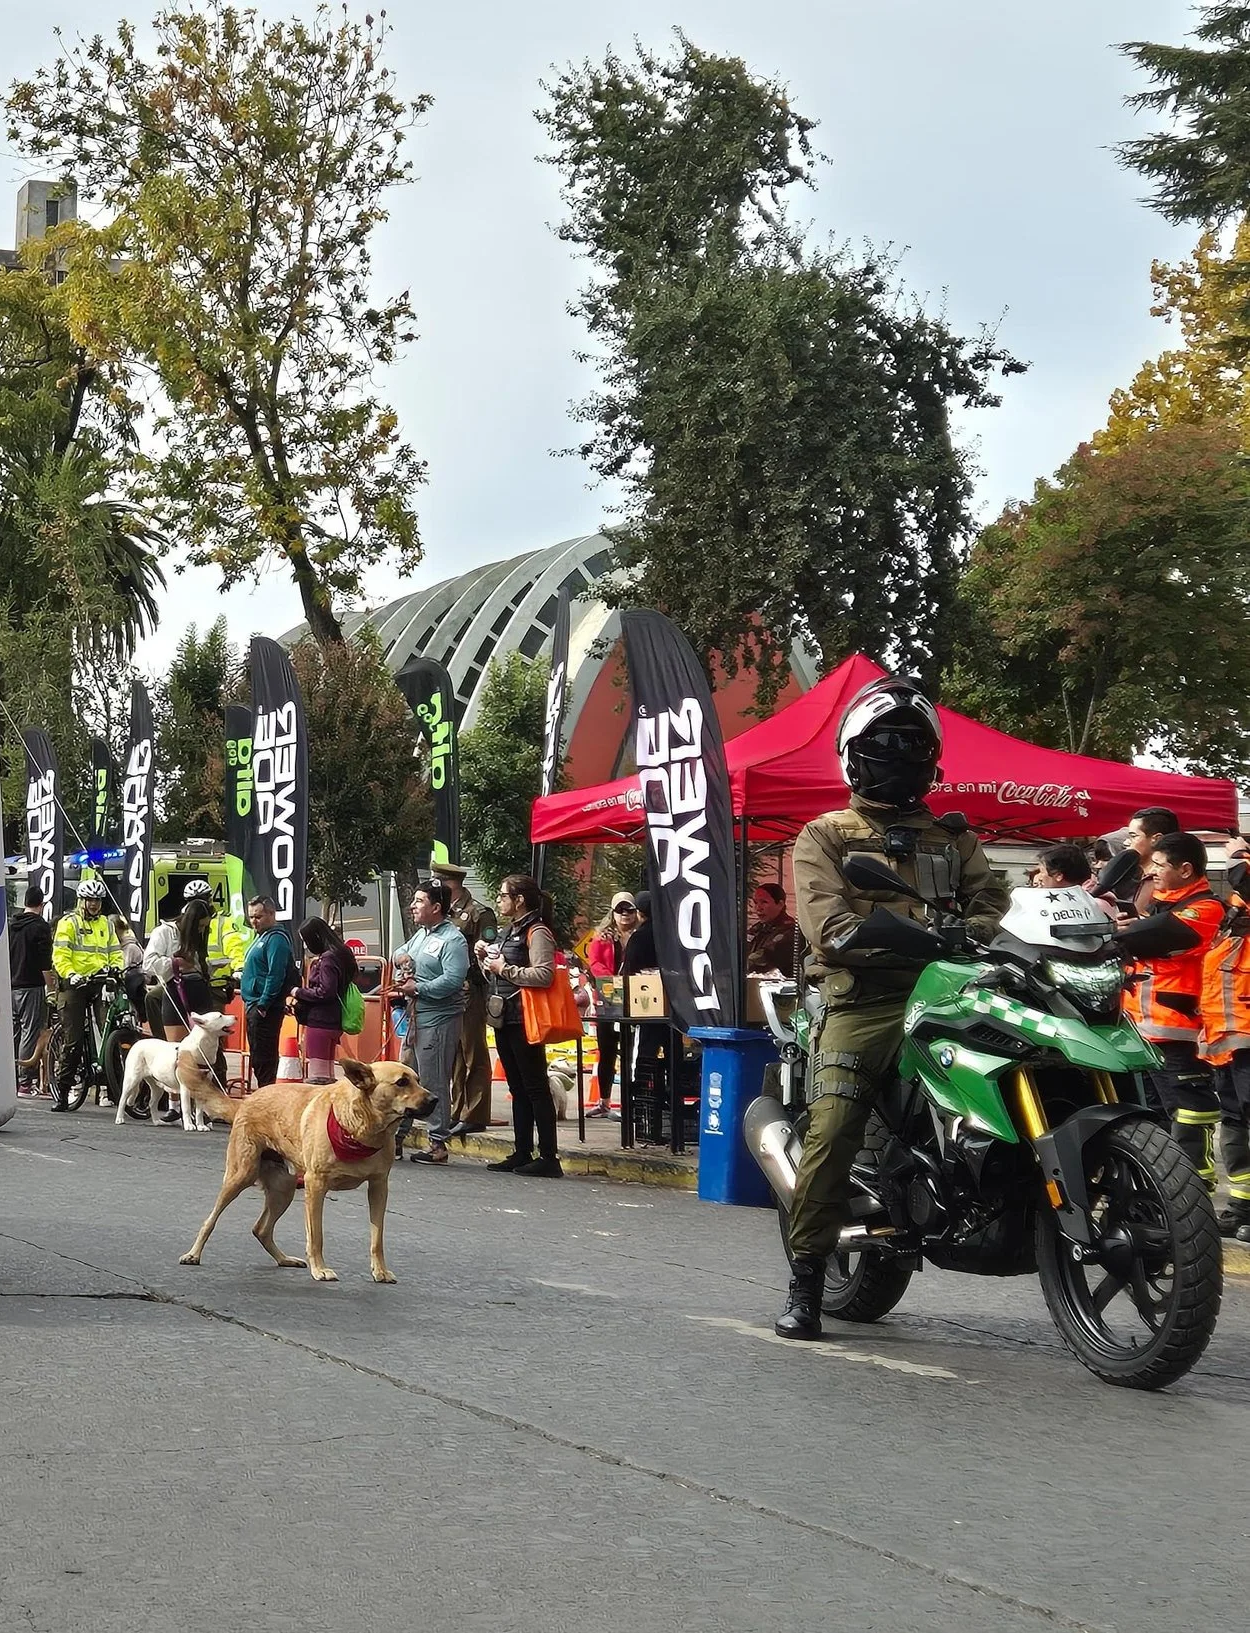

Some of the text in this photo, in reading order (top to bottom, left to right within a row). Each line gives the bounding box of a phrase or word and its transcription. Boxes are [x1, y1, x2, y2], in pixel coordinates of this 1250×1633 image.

[956, 782, 976, 793] en
[978, 781, 996, 794] mi
[212, 881, 225, 908] 4
[1052, 909, 1083, 922] DELTA
